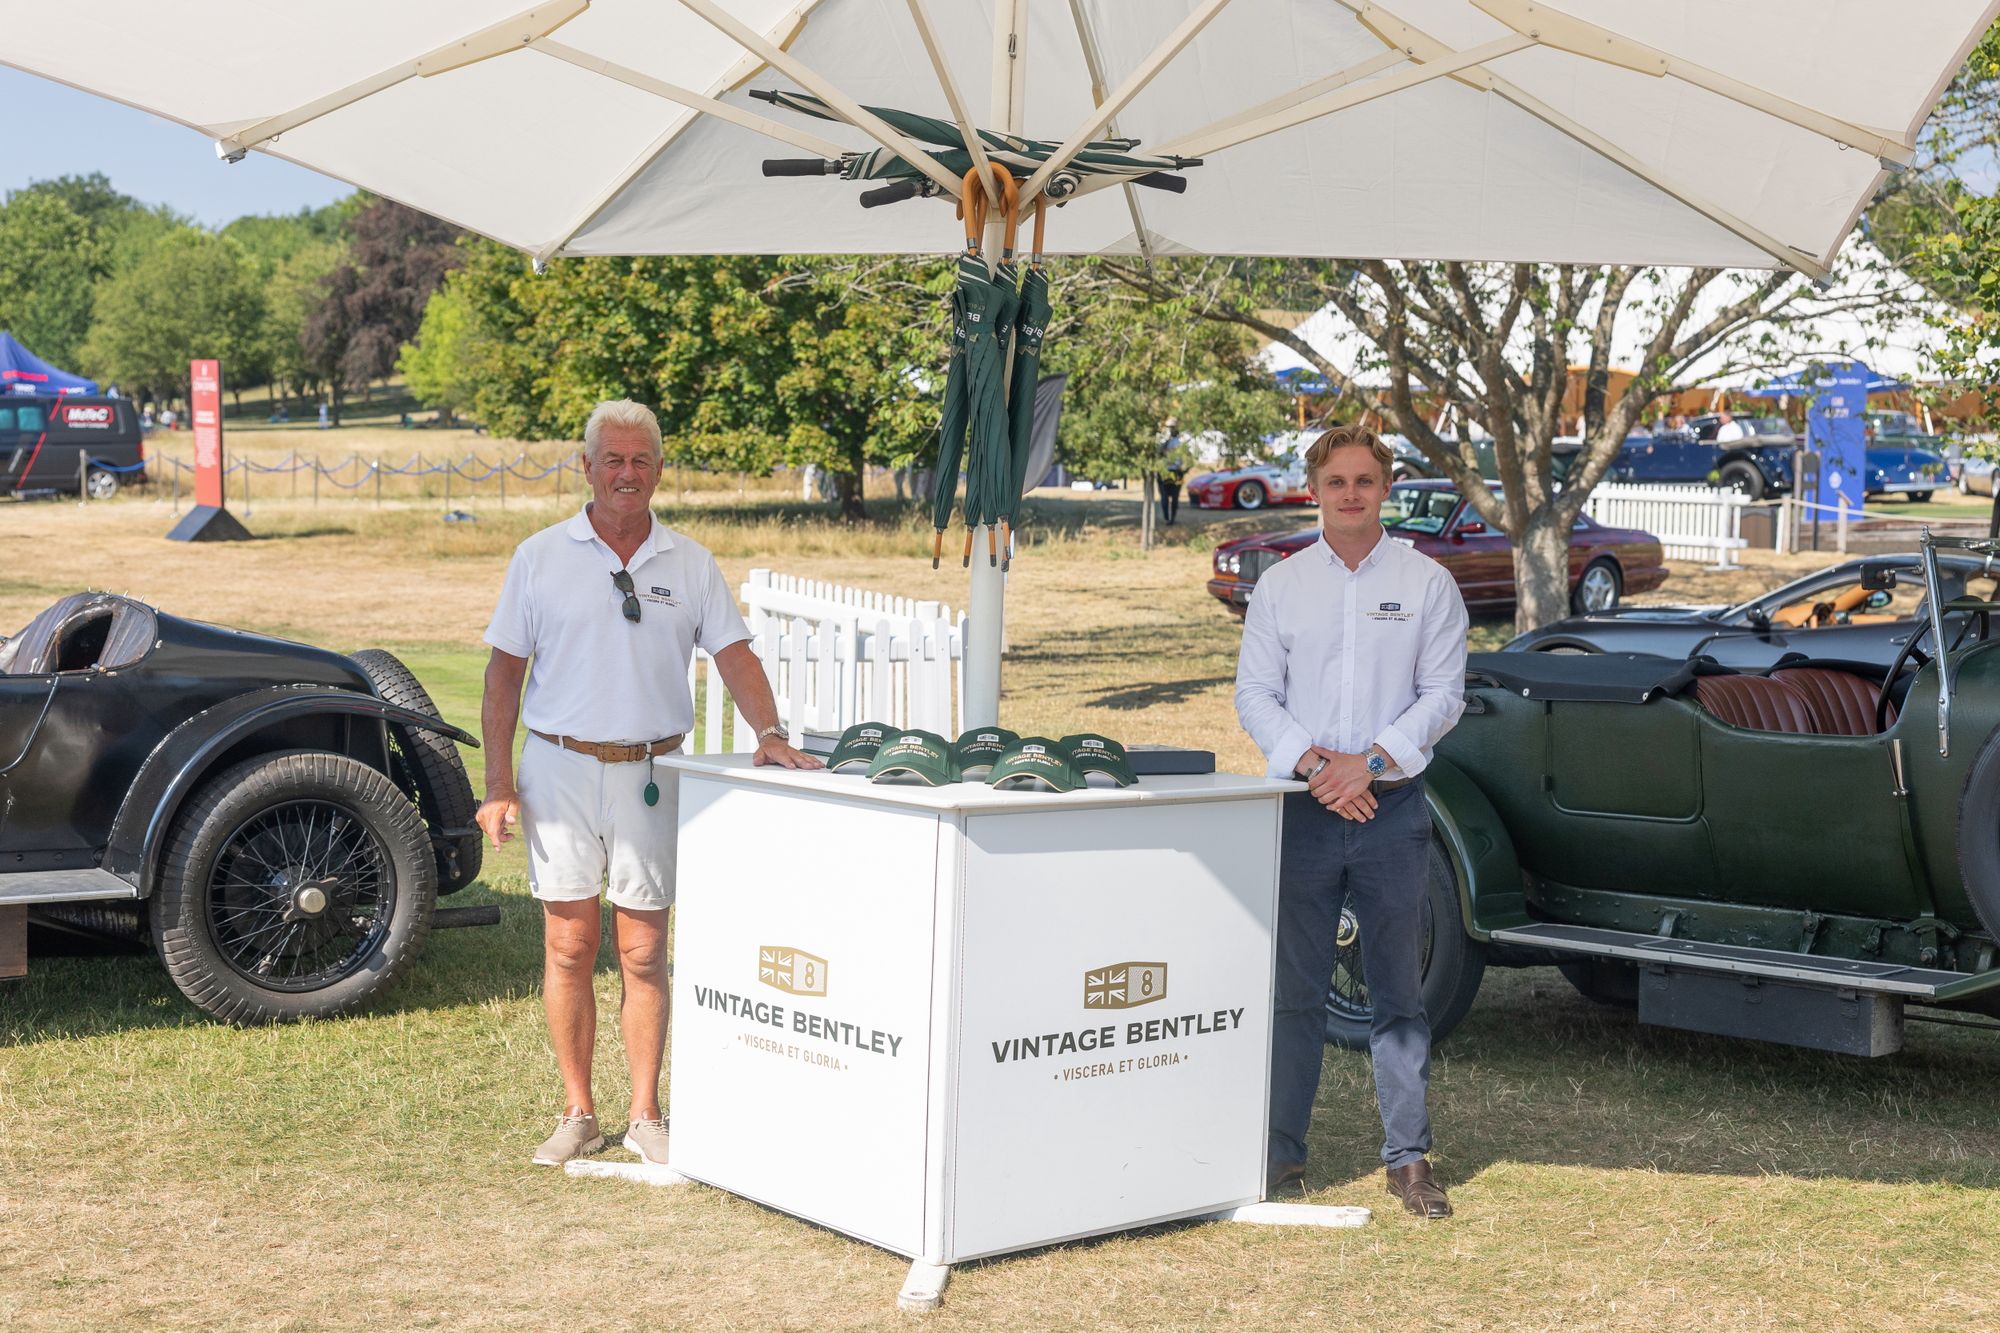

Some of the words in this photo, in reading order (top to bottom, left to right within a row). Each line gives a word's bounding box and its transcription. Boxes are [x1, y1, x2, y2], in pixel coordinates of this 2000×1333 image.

[883, 744, 908, 756] VINTAGE
[909, 744, 939, 759] BENTLEY
[960, 742, 986, 753] VINTAGE
[1005, 753, 1032, 764] VINTAGE
[1033, 753, 1063, 767] BENTLEY
[1093, 748, 1120, 762] BENTLEY
[803, 961, 816, 989] 8
[1140, 969, 1154, 997] 8
[694, 984, 784, 1029] VINTAGE
[793, 1010, 903, 1058] BENTLEY
[991, 1025, 1116, 1064] VINTAGE
[1126, 1007, 1245, 1044] BENTLEY
[744, 1033, 784, 1056] VISCERA
[787, 1045, 800, 1059] ET
[803, 1050, 841, 1071] GLORIA
[1062, 1062, 1115, 1082] VISCERA
[1119, 1059, 1134, 1074] ET
[1137, 1052, 1180, 1070] GLORIA
